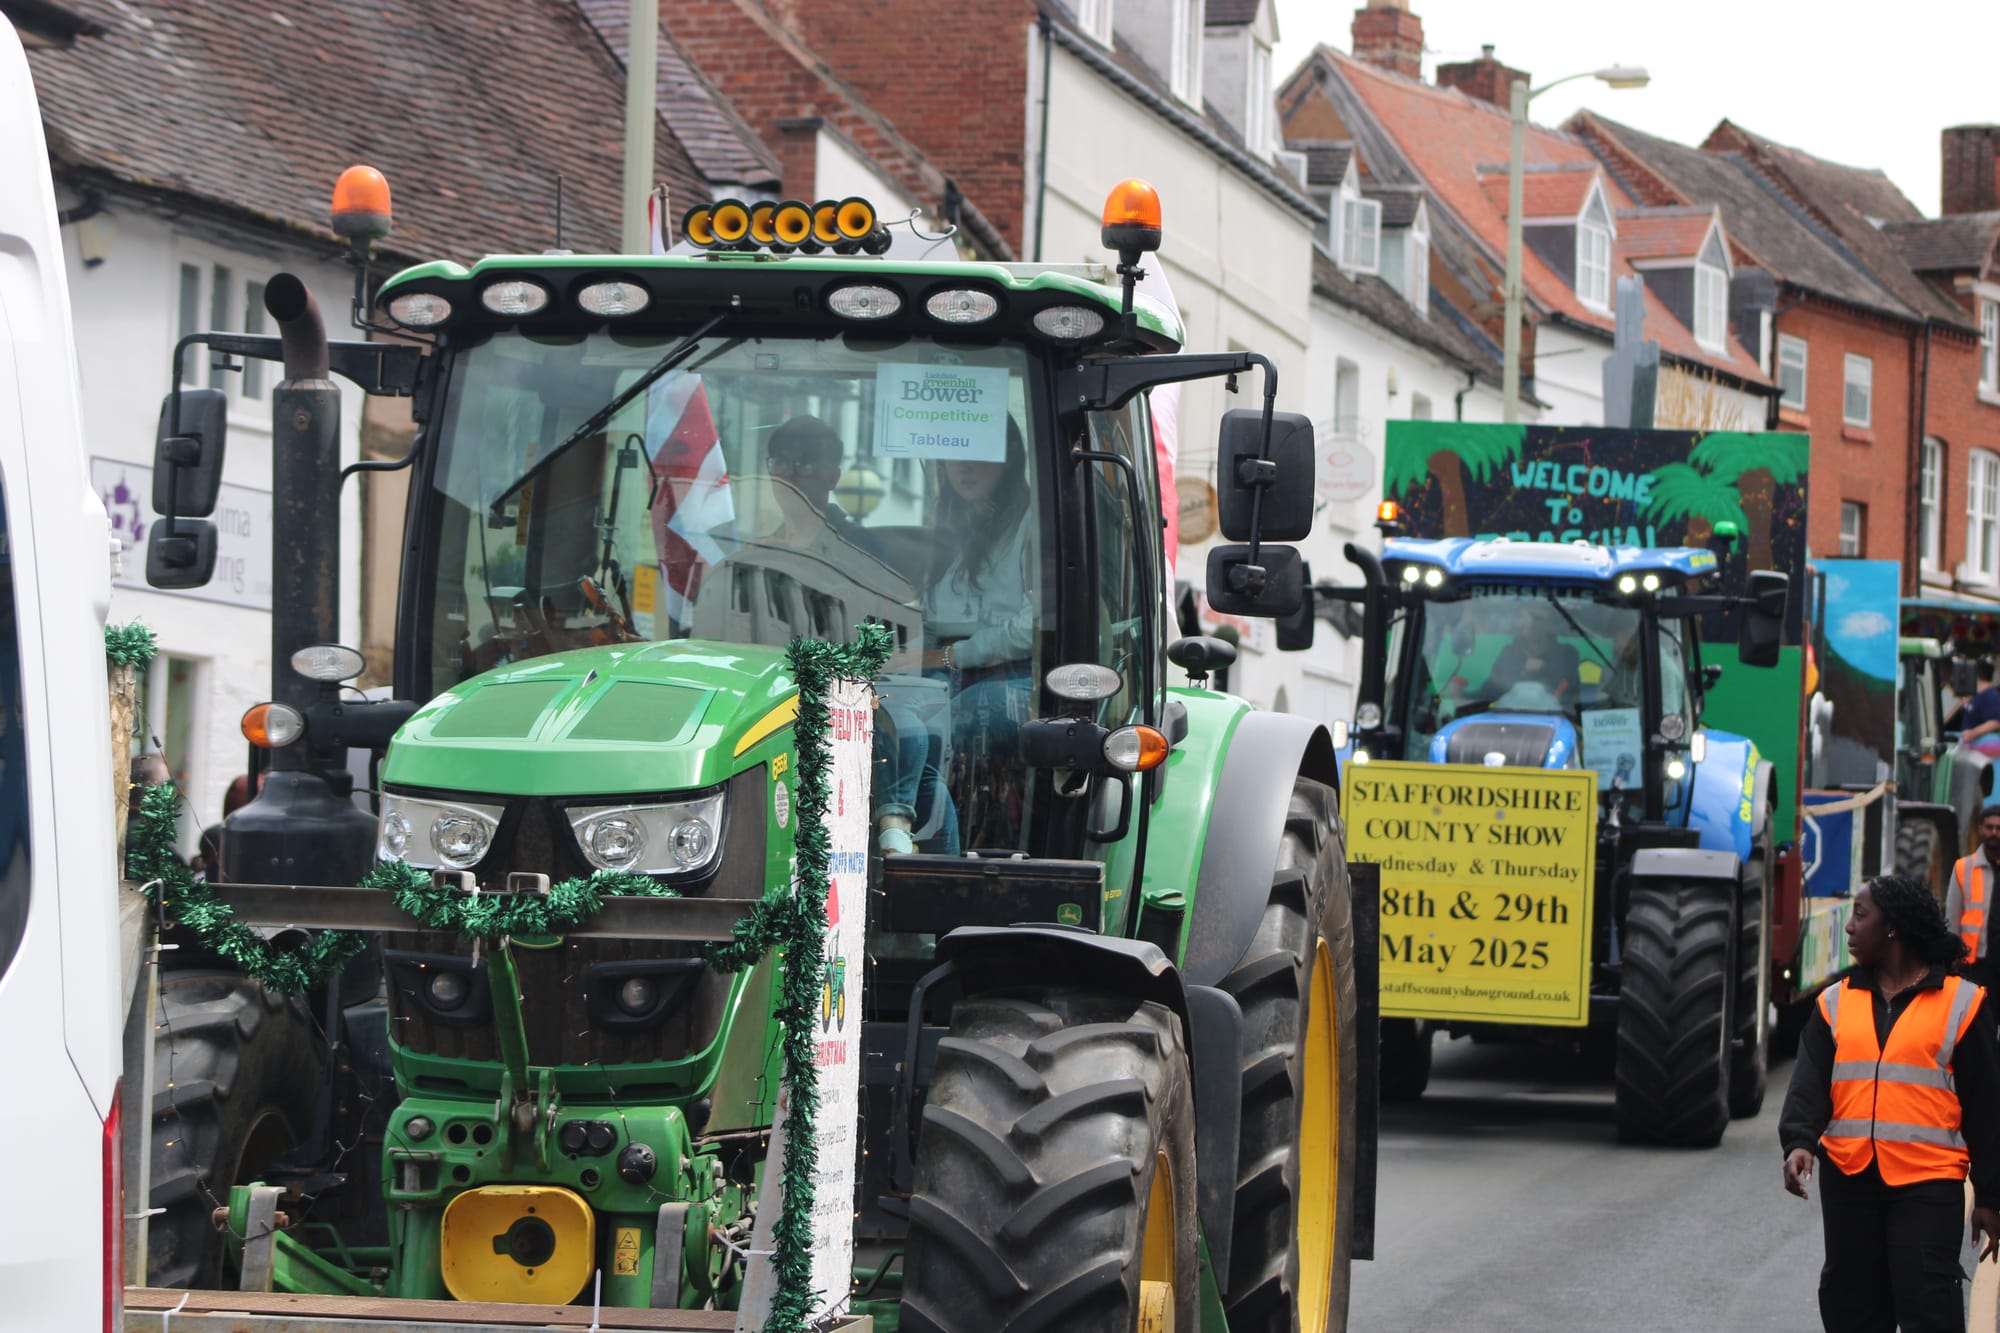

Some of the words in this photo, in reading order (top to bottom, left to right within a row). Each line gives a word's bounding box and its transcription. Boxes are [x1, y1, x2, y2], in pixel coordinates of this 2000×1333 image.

[901, 380, 983, 403] Bower
[893, 406, 989, 423] Competitive
[909, 432, 970, 448] Tableau
[1510, 460, 1656, 504] WELCOME
[1353, 781, 1582, 811] STAFFORDSHIRE
[1365, 818, 1480, 843] COUNTY
[1488, 823, 1567, 847] SHOW
[1469, 859, 1484, 875] &
[1491, 858, 1580, 882] Thursday
[1381, 887, 1435, 917] 8th
[1449, 891, 1479, 920] &
[1494, 894, 1568, 924] 29th
[1380, 934, 1456, 973] May
[1469, 938, 1549, 969] 2025
[1380, 983, 1571, 1002] .staffscountyshowground.co.uk
